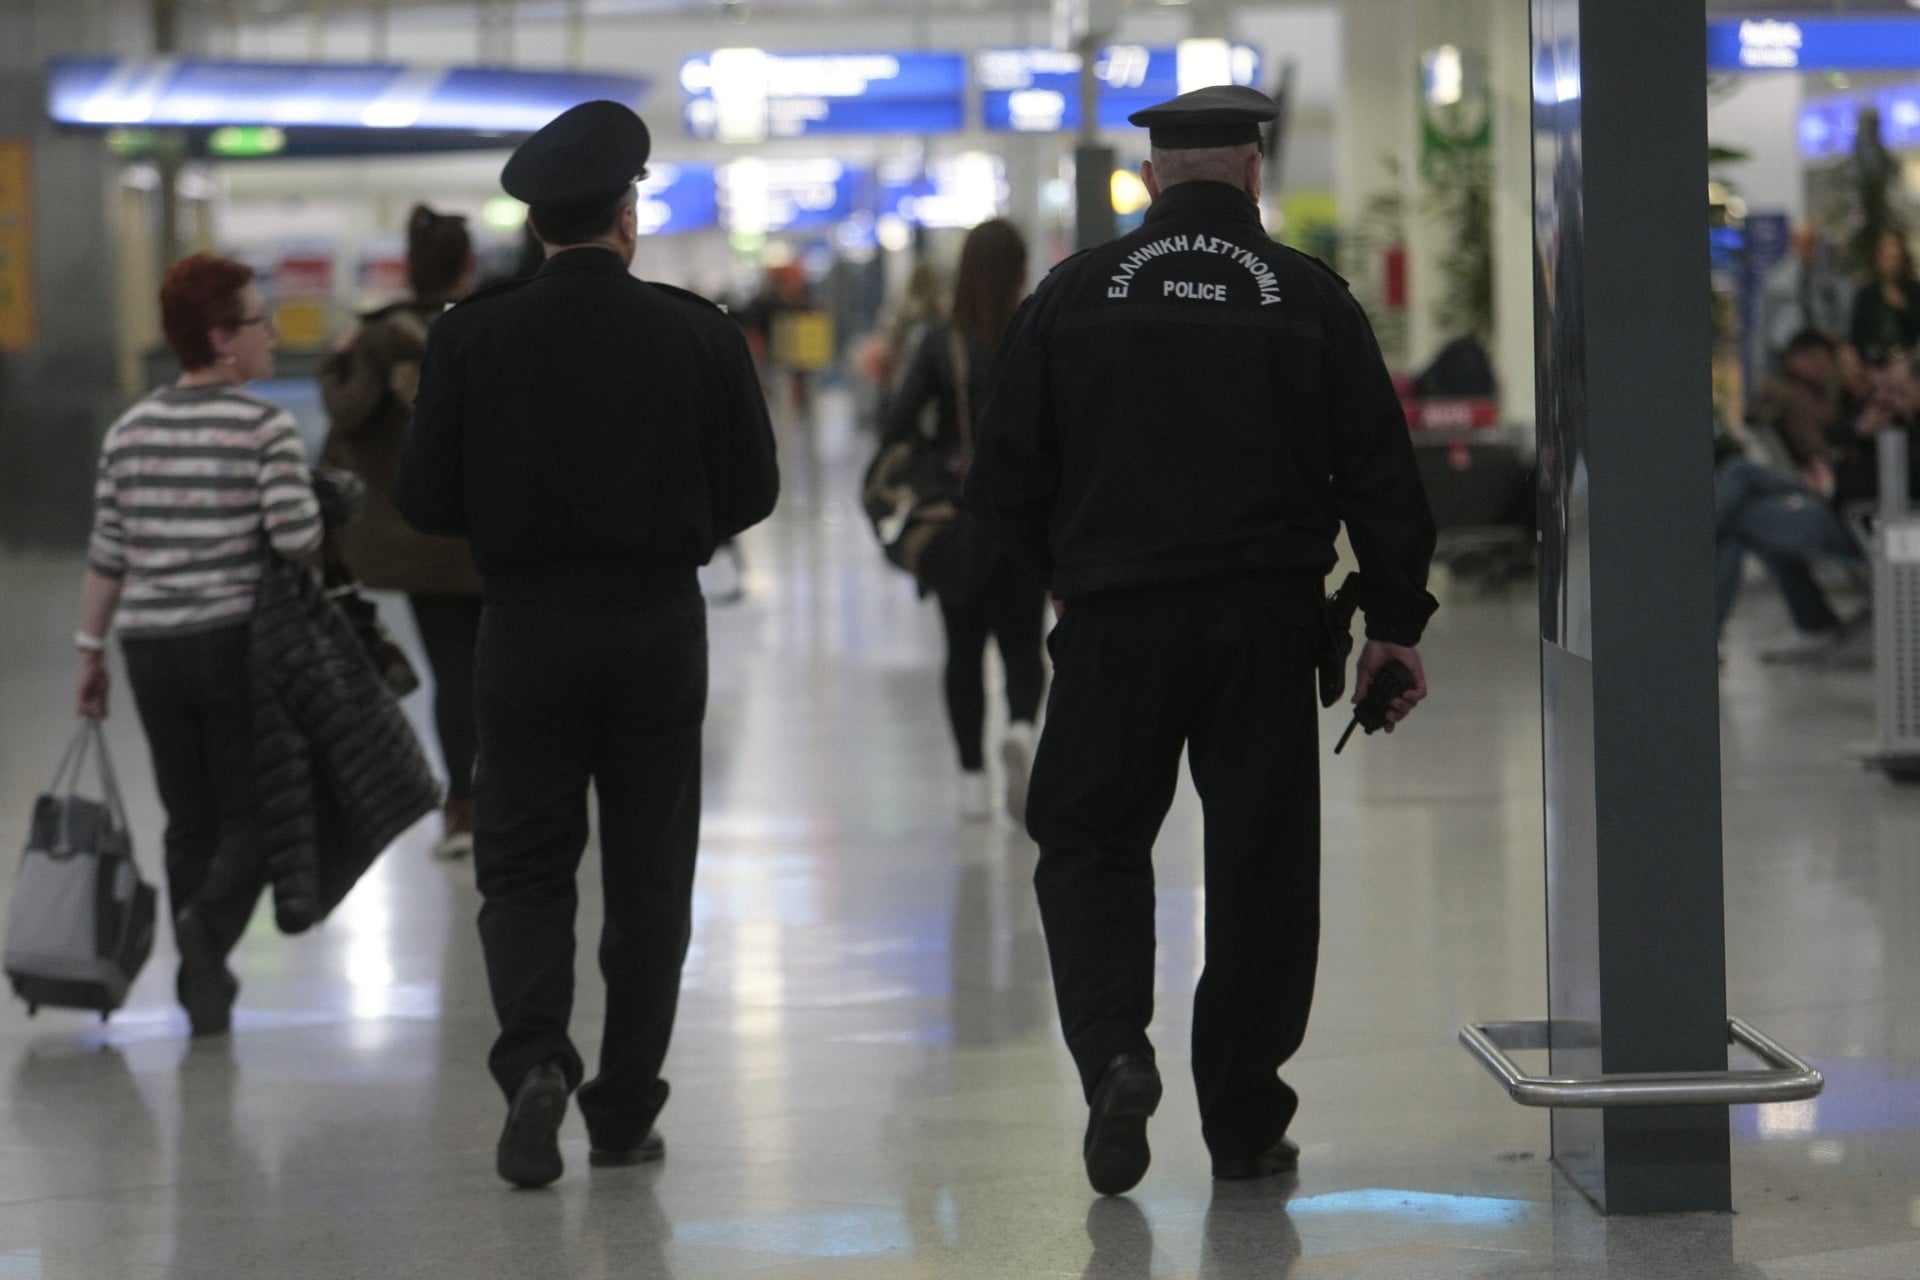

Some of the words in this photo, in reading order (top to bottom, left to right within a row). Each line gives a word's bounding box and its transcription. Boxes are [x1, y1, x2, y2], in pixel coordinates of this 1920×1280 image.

[1108, 235, 1189, 298] ΕΛΛΗΝΙΚΗ
[1192, 234, 1281, 305] ΑΣΤΥΝΟΜΙΑ
[1163, 281, 1226, 302] POLICE
